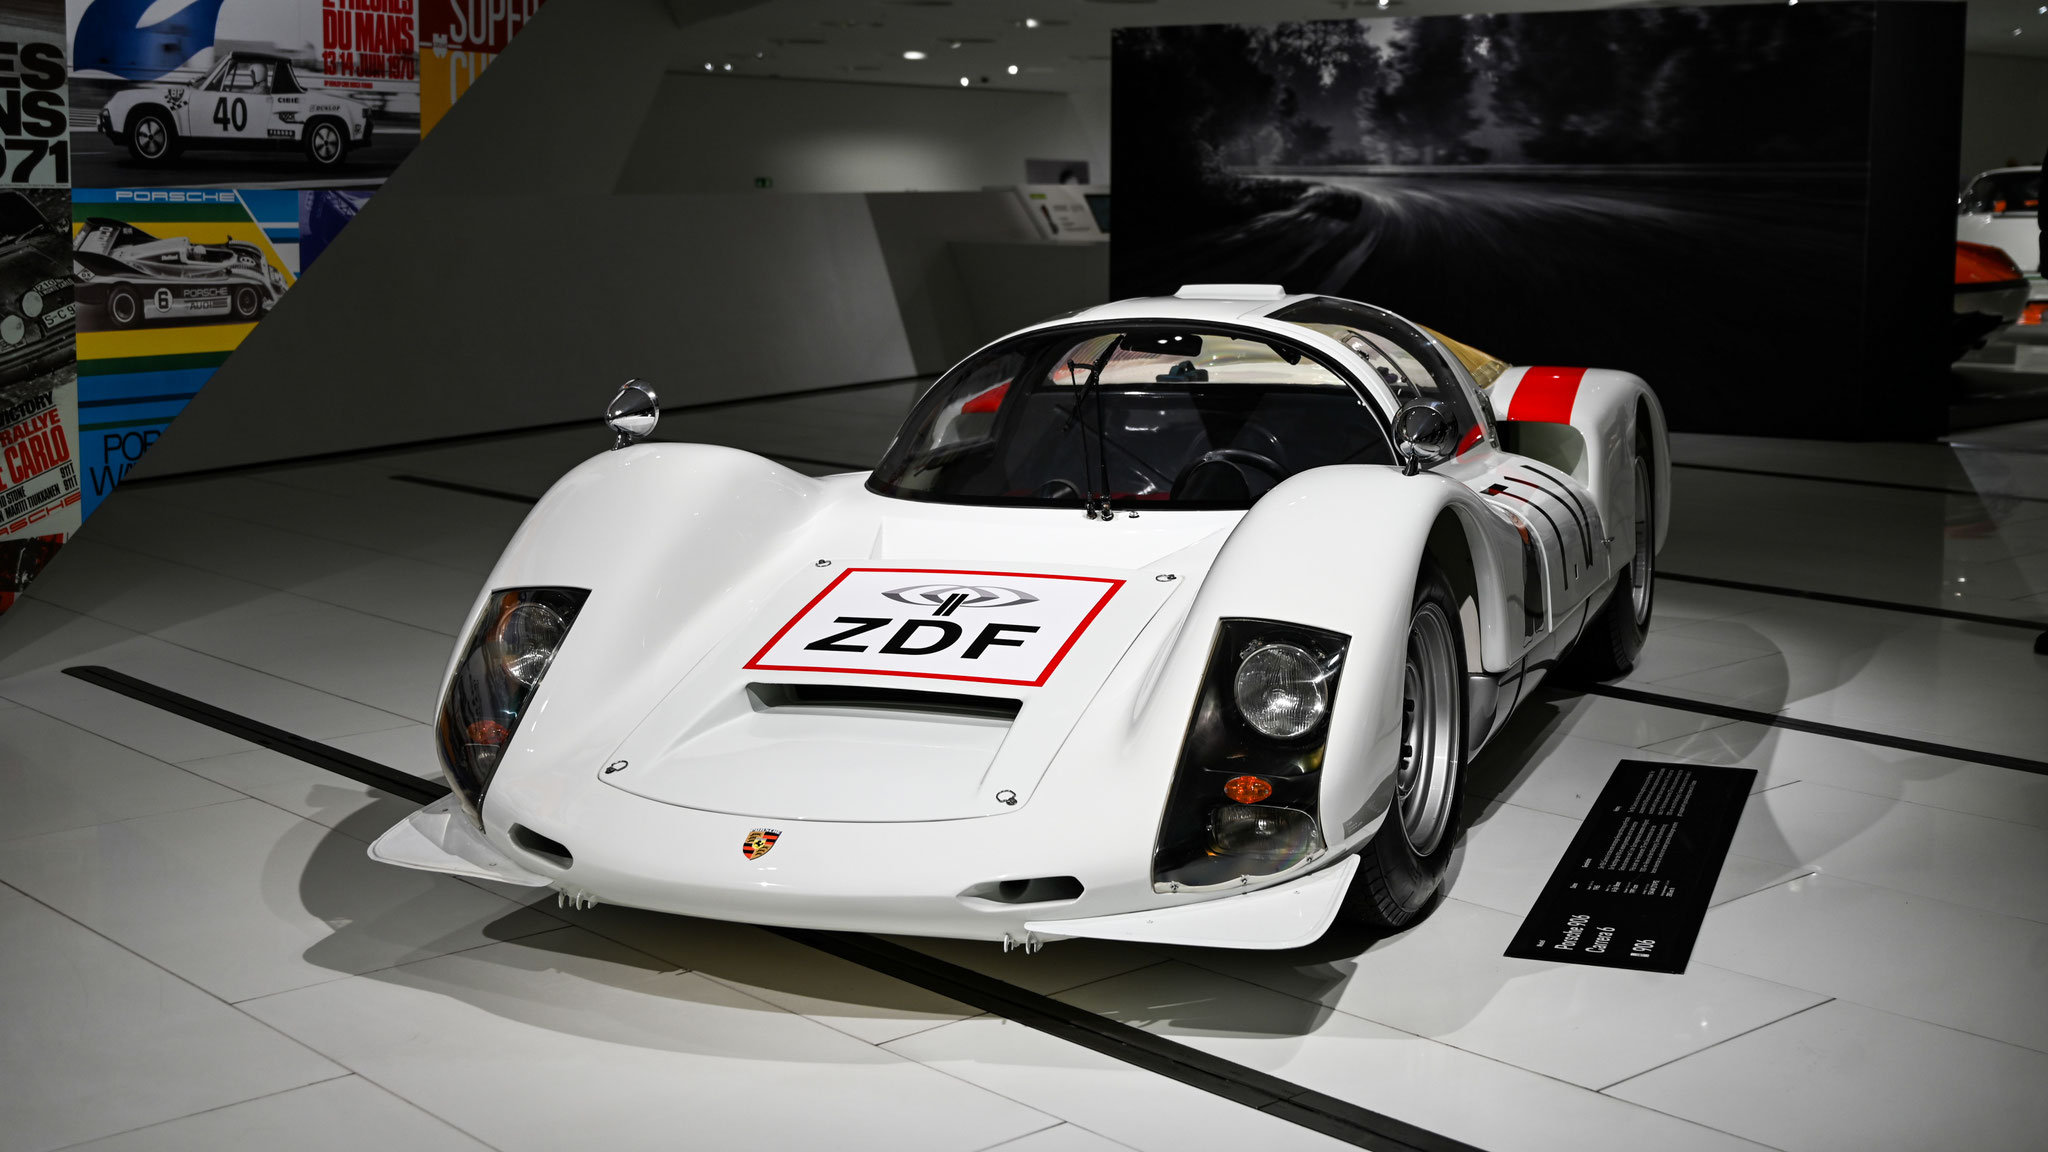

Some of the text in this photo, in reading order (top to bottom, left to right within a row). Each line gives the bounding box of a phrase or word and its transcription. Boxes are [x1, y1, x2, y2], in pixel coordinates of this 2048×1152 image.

[323, 9, 414, 55] DU MANS
[322, 51, 414, 80] 13 14 JUIN 1970
[213, 97, 247, 131] 40
[0, 138, 69, 183] 71
[116, 191, 236, 202] PORSCHE
[158, 291, 169, 310] 6
[183, 287, 228, 297] PORSCHE
[189, 301, 213, 310] AUDI
[0, 408, 61, 447] RALLYE
[4, 424, 70, 484] CARLO
[6, 485, 26, 504] STONE
[4, 499, 28, 519] MARTTI
[803, 616, 1041, 660] ZDF
[1554, 914, 1591, 950] Porsche 906
[1585, 931, 1614, 953] Carrera
[1632, 939, 1656, 952] 906
